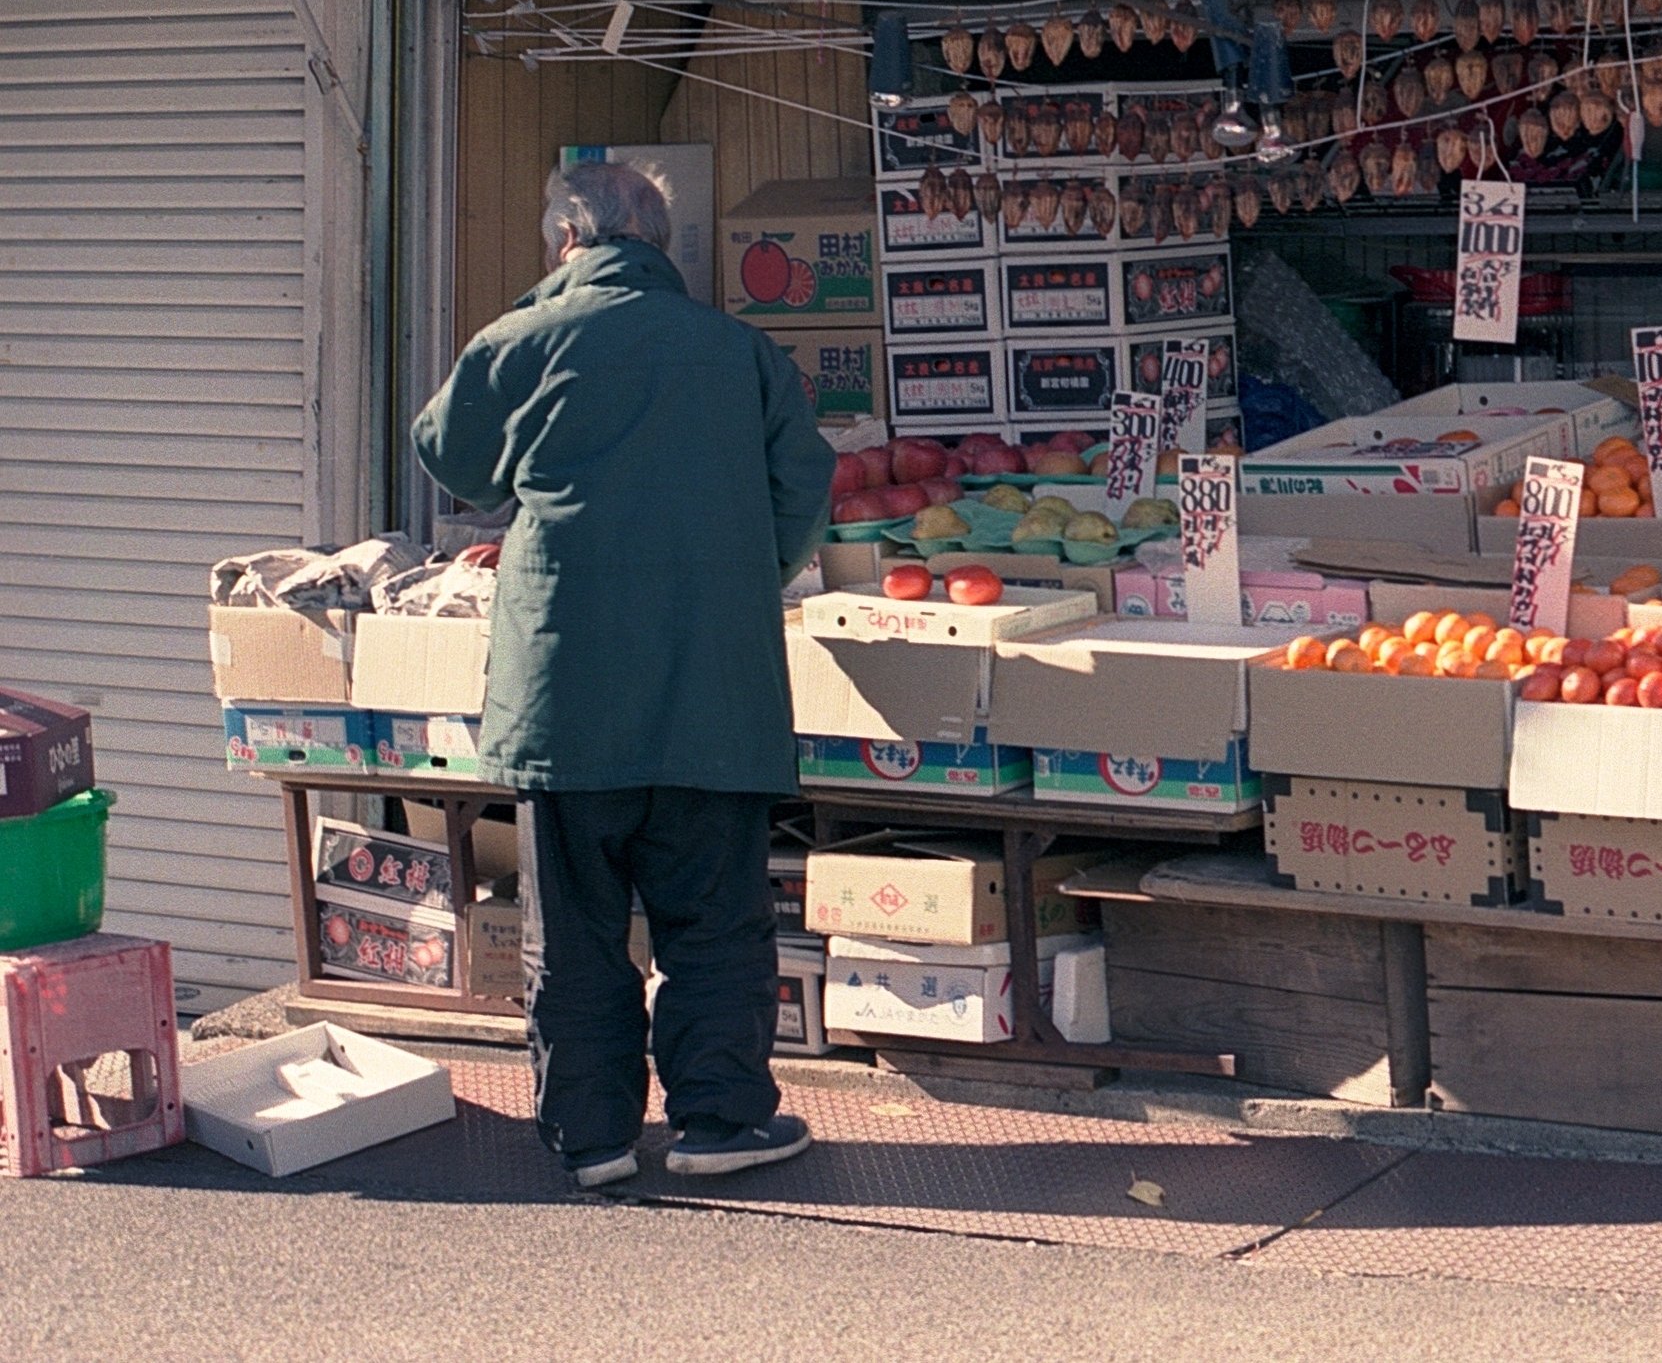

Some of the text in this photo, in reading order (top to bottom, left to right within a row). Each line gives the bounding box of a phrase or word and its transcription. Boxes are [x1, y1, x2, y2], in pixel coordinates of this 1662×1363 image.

[819, 232, 865, 257] 田村
[1461, 221, 1521, 255] 1000
[819, 260, 867, 276] みかん
[820, 346, 865, 371] 田村
[1163, 356, 1204, 388] 400
[820, 373, 868, 390] みかん
[1112, 409, 1156, 439] 300
[1181, 478, 1231, 514] 880
[1523, 478, 1574, 519] 800
[875, 972, 938, 998] 共 選
